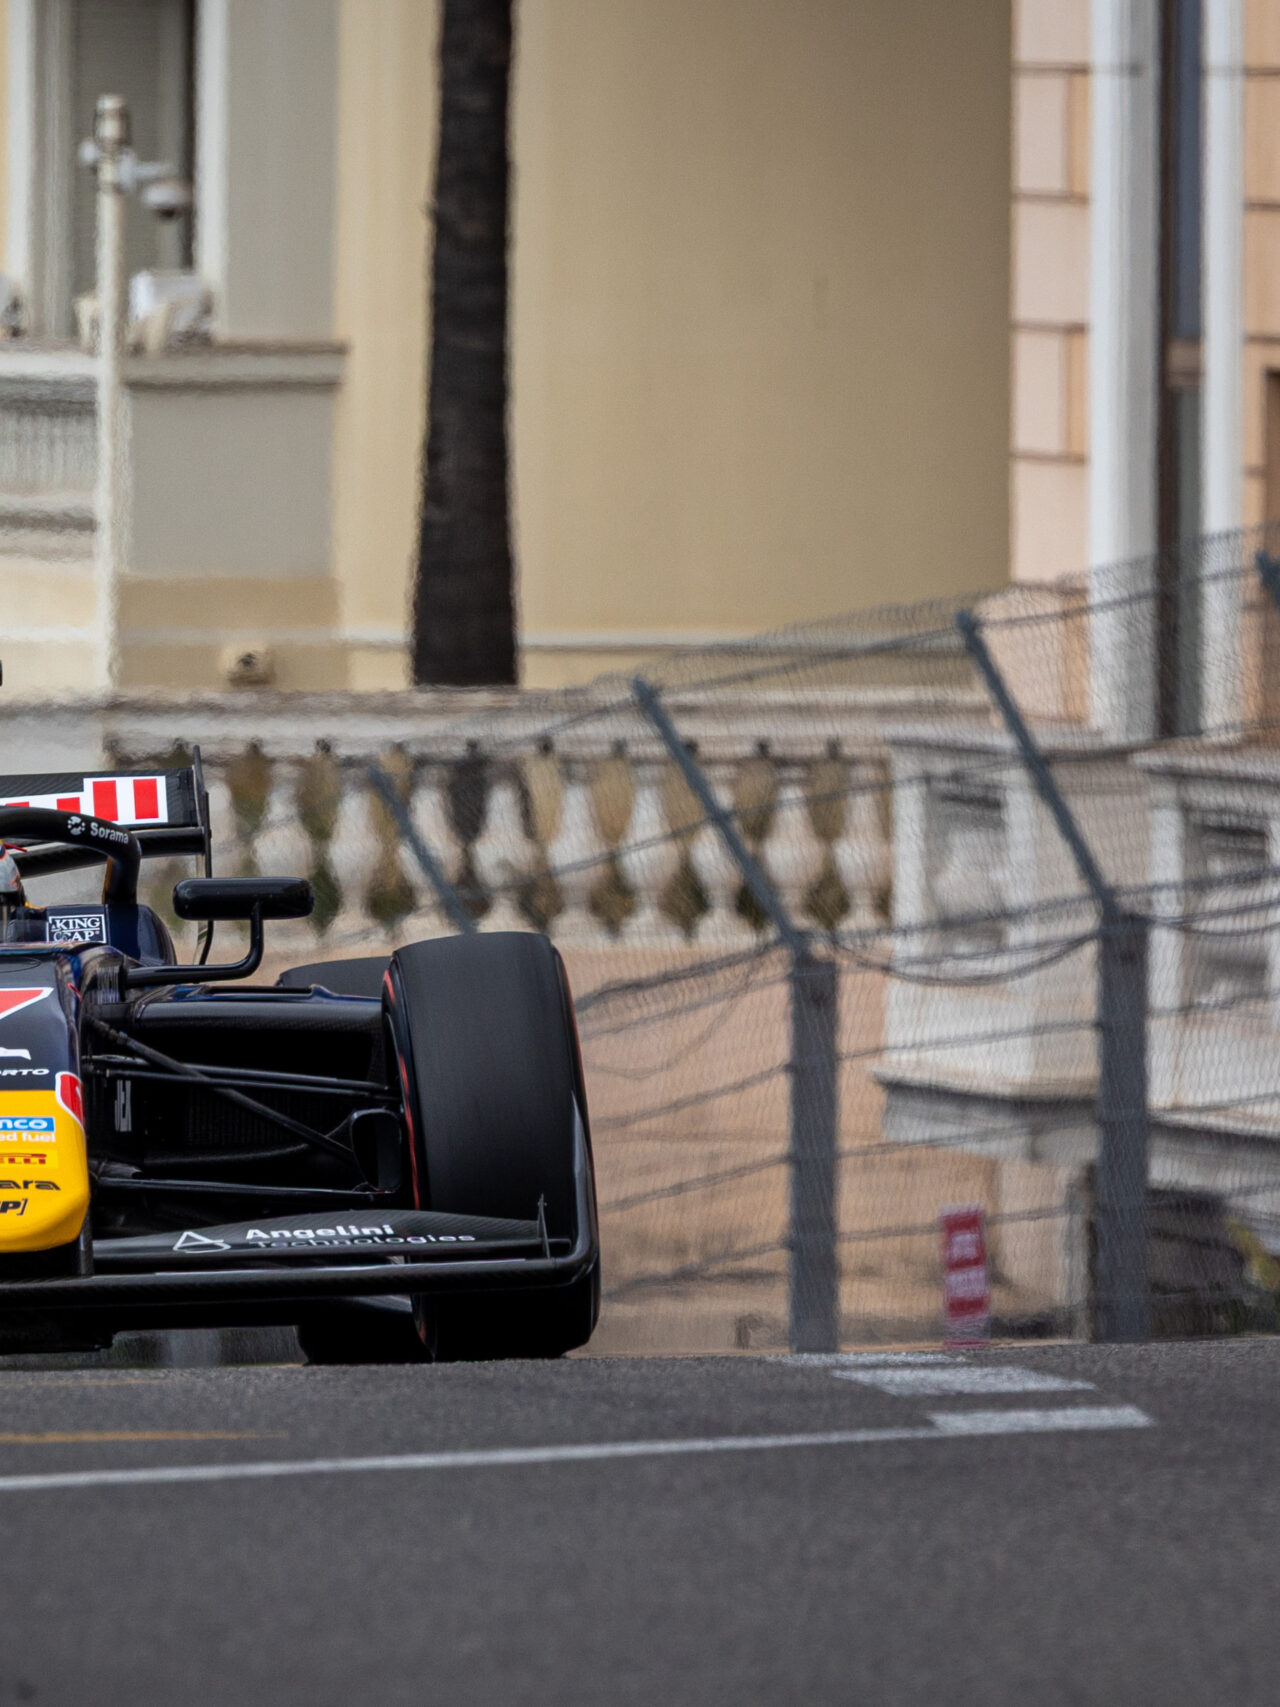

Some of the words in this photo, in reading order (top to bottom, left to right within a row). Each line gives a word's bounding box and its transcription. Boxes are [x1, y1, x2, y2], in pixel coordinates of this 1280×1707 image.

[90, 822, 129, 844] Sorama
[54, 917, 100, 930] KING
[22, 1131, 56, 1144] fuel
[245, 1224, 396, 1240] Angelini
[248, 1233, 476, 1249] Technologies
